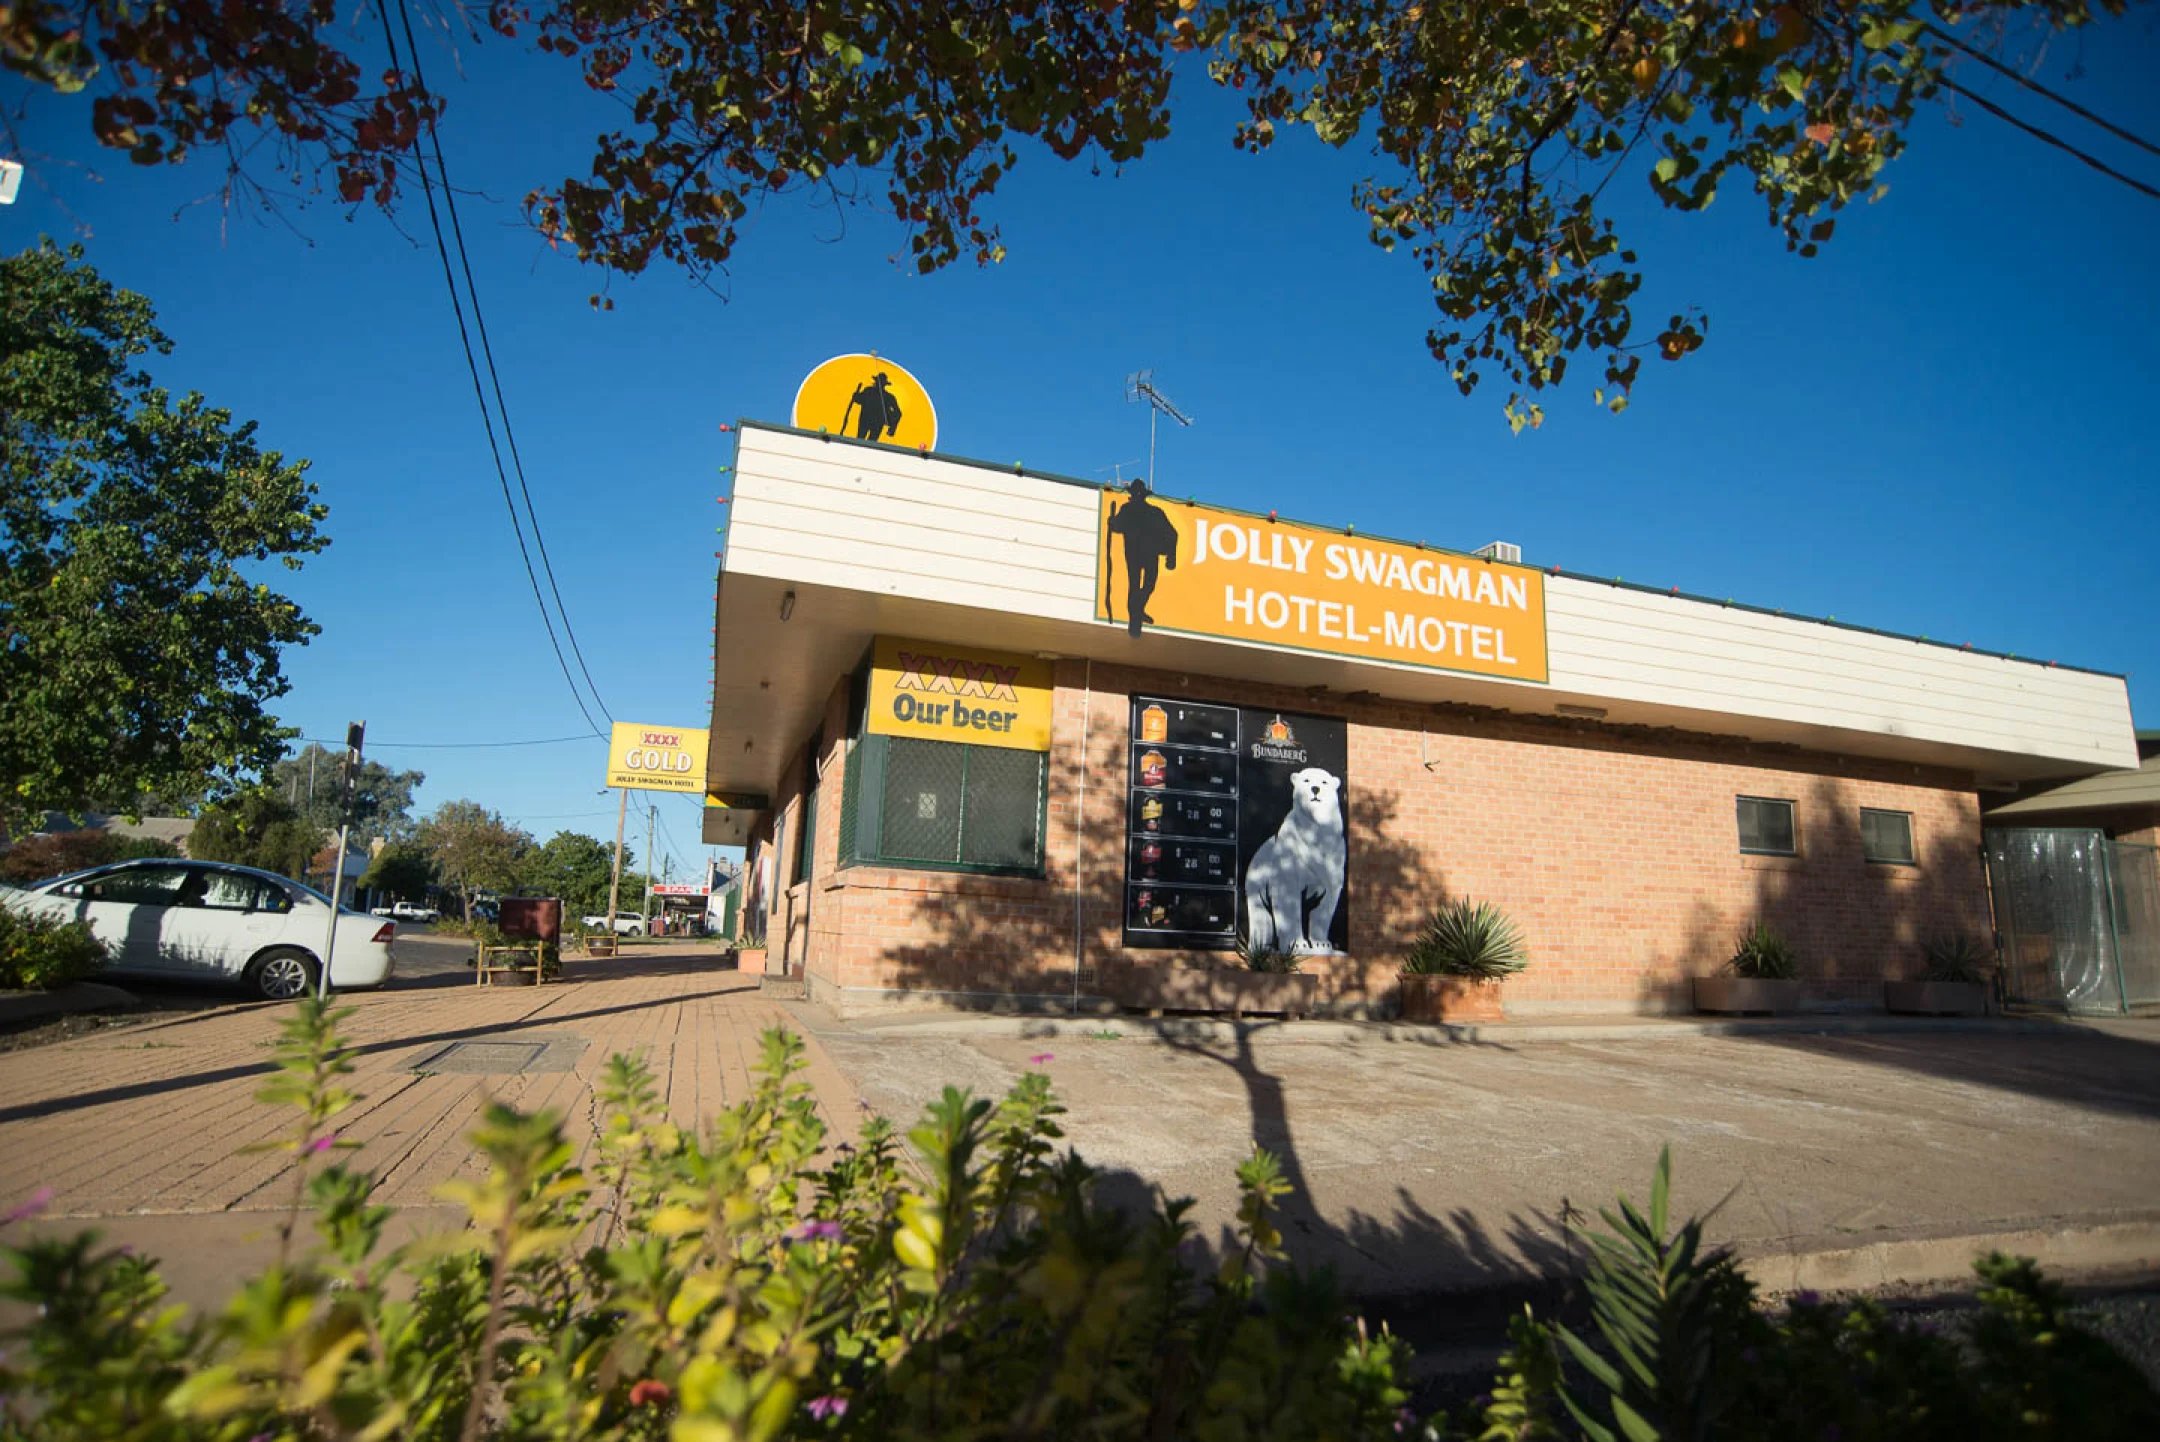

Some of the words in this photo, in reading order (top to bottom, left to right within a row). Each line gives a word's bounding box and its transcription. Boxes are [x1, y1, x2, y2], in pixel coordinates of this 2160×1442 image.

[1193, 519, 1314, 574] JOLLY
[1326, 543, 1527, 611] SWAGMAN
[1225, 585, 1518, 664] HOTEL-MOTEL
[895, 652, 1020, 702] XXXX
[893, 693, 949, 725] Our
[953, 699, 1017, 732] beer
[644, 733, 679, 746] XXXX
[1251, 743, 1307, 762] BUNDABERG
[626, 749, 692, 772] GOLD
